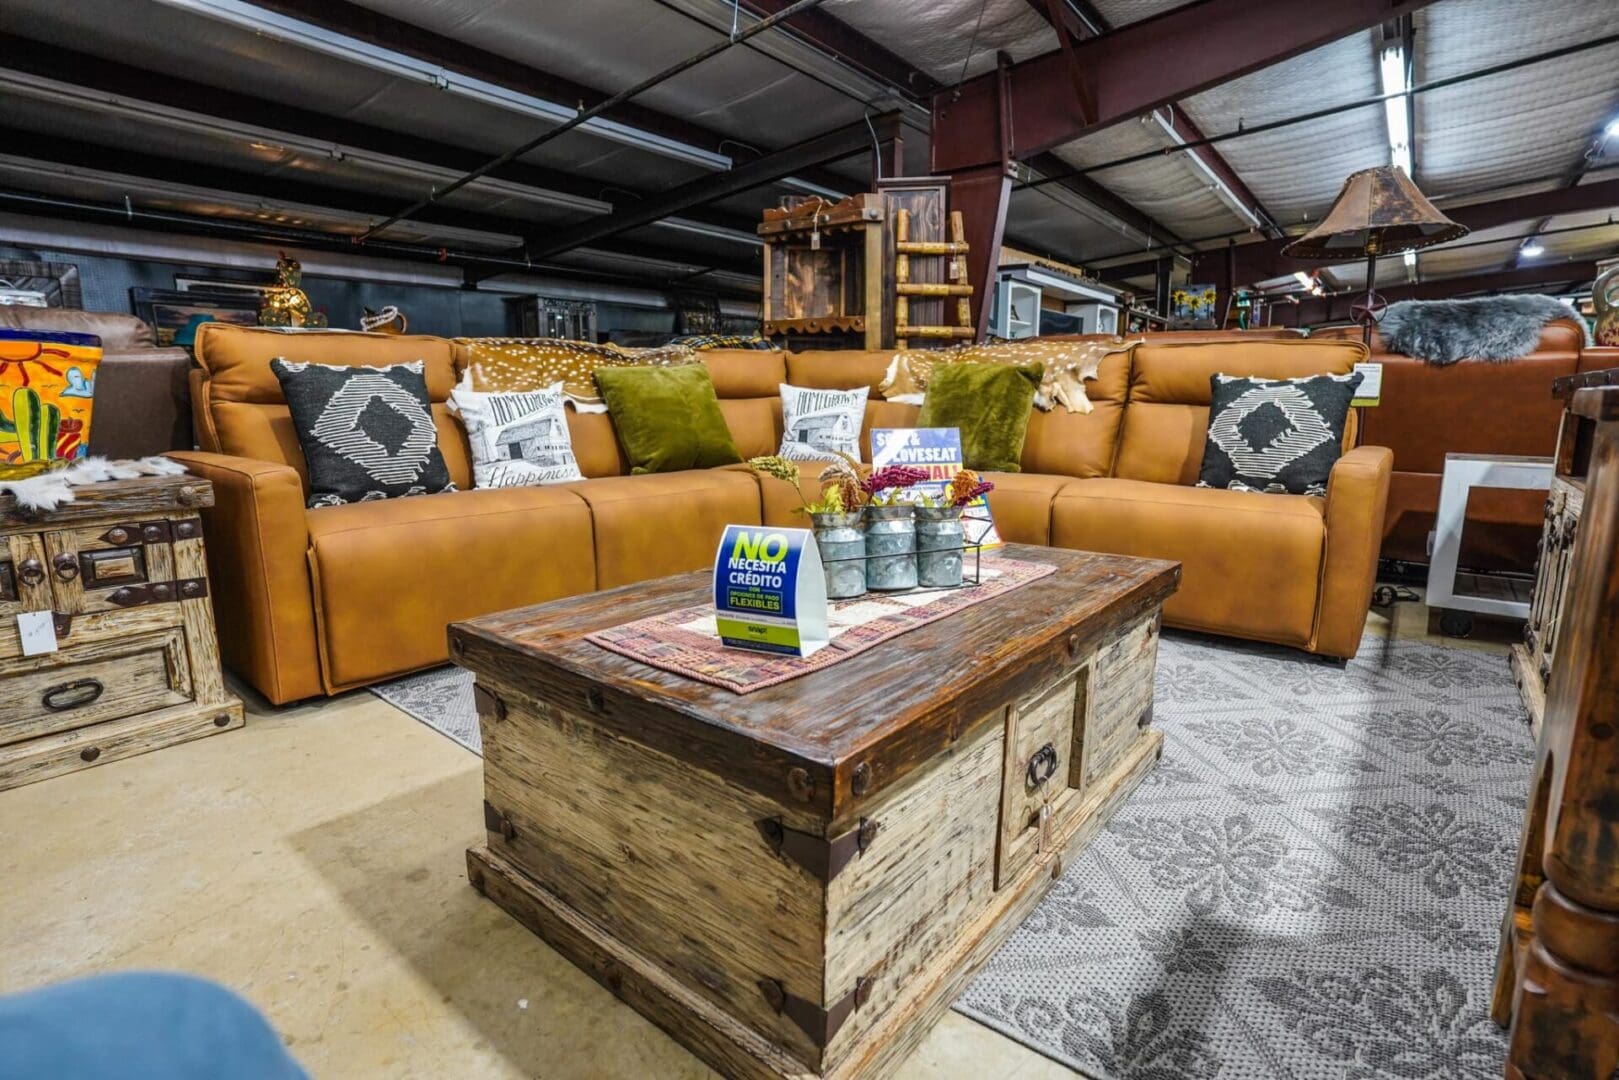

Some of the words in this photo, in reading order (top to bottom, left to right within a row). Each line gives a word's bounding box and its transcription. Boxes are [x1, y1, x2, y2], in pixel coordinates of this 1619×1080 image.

[796, 392, 859, 416] HOMEGROWN
[893, 447, 957, 462] LOVESEAT
[732, 531, 788, 562] NO
[728, 558, 787, 574] NECESITA
[729, 571, 782, 588] CRÉDITO
[730, 597, 780, 610] FLEXIBLES
